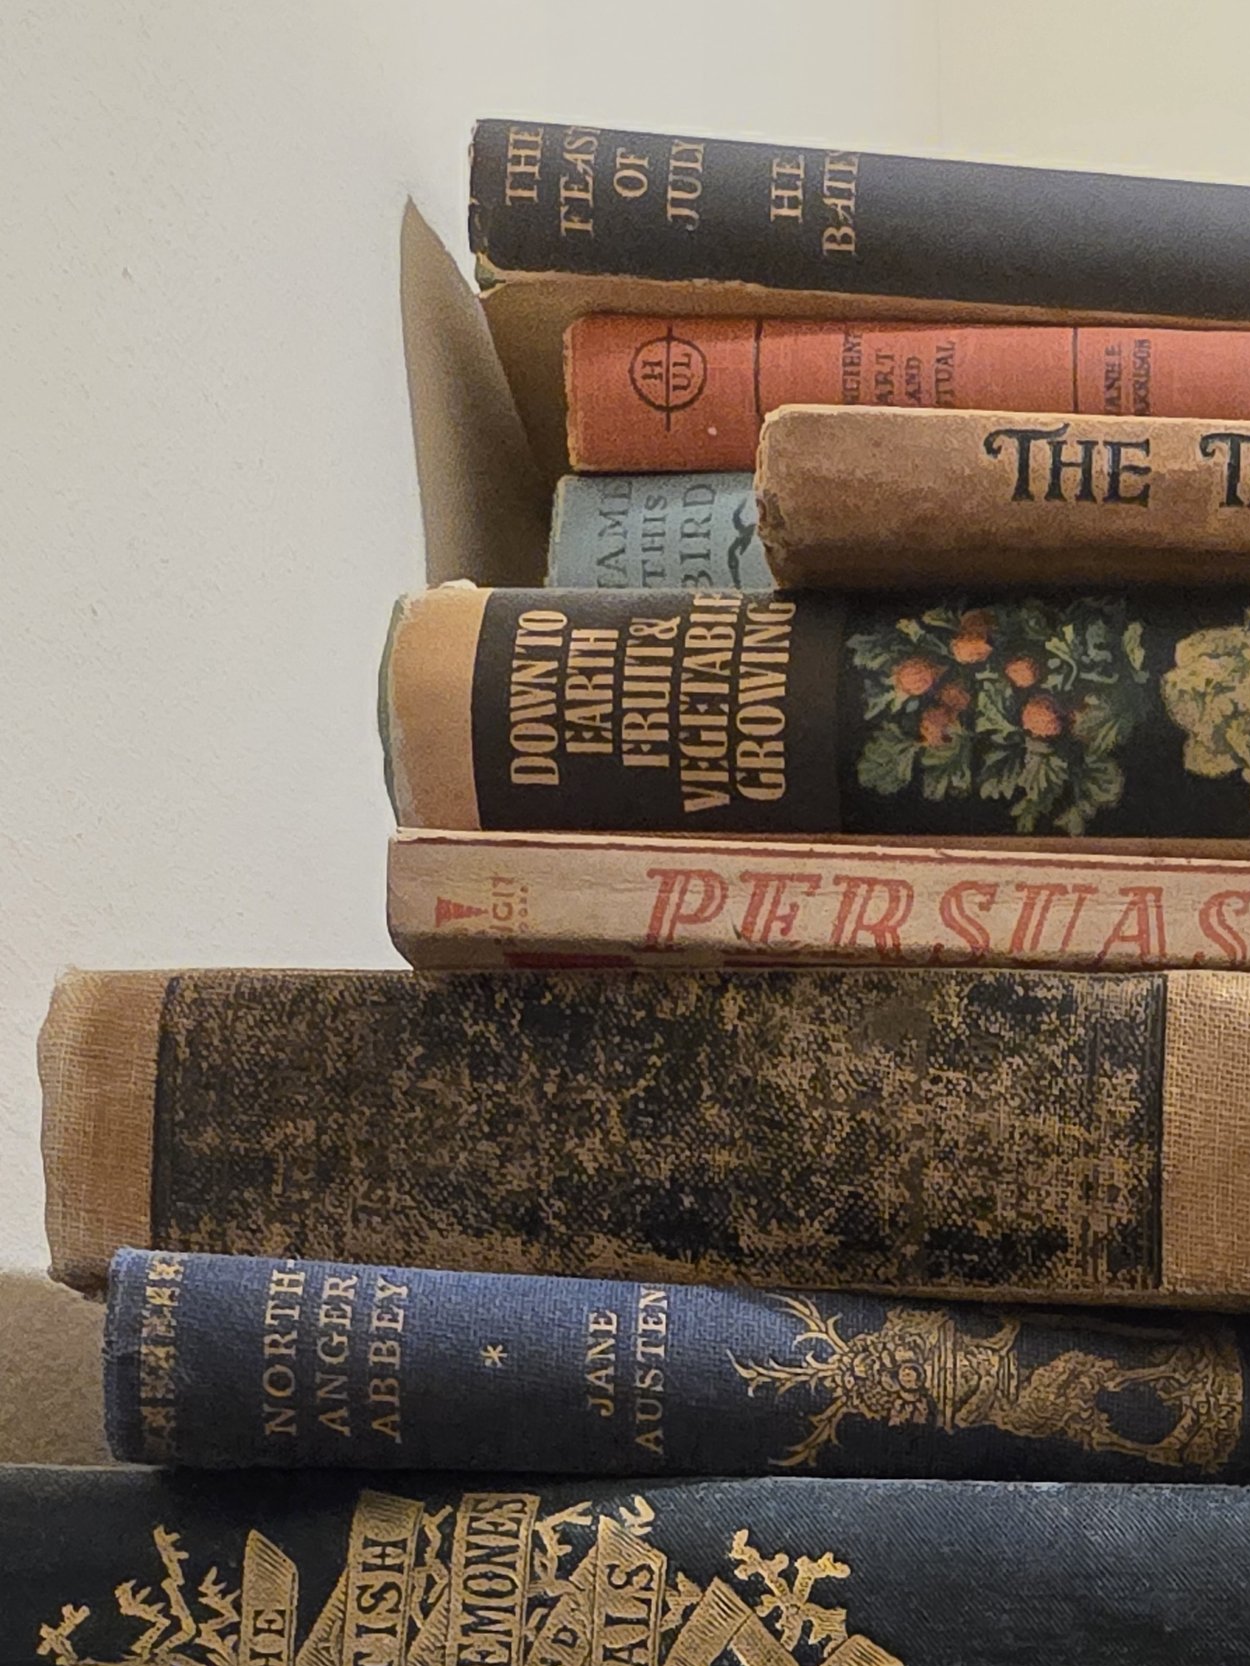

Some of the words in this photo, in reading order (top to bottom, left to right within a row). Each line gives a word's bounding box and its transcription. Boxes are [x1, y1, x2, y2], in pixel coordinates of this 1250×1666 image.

[505, 126, 543, 205] THE
[613, 145, 650, 199] OF
[667, 138, 705, 231] JULY
[873, 348, 896, 405] ART
[984, 422, 1151, 508] THE
[641, 493, 668, 588] THIS
[516, 609, 568, 652] TO
[630, 616, 681, 638] &
[510, 658, 560, 786] DOWN
[565, 627, 620, 754] EARTH
[622, 639, 675, 768] FRUIT
[679, 592, 742, 813] VEGETABLE
[735, 600, 797, 801] GROWING
[317, 1273, 359, 1437] ANGER
[368, 1275, 409, 1444] ABBEY
[585, 1309, 619, 1418] JANE
[635, 1283, 670, 1456] AUSTEN
